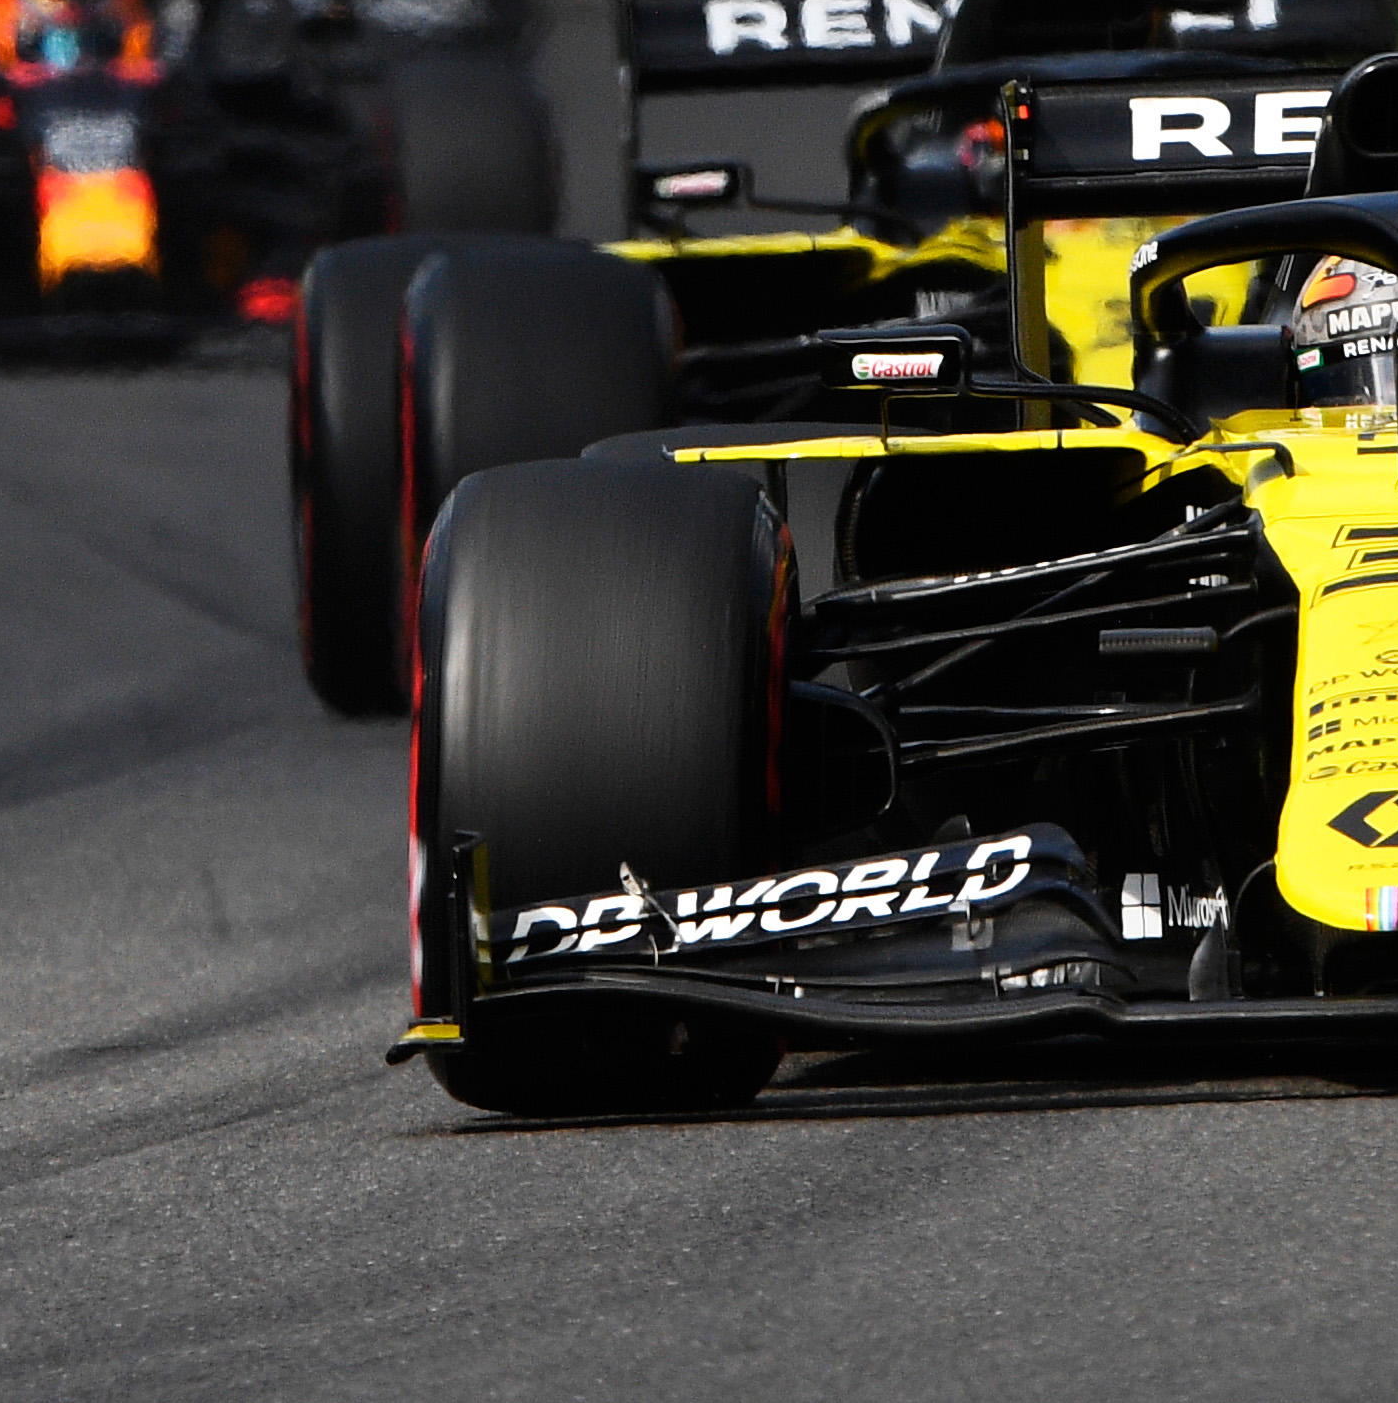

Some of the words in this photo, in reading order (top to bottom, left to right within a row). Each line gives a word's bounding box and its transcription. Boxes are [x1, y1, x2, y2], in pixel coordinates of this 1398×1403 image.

[872, 359, 933, 378] Castrol
[1308, 674, 1350, 694] DP
[505, 896, 644, 964] DP
[674, 835, 1033, 945] WORLD
